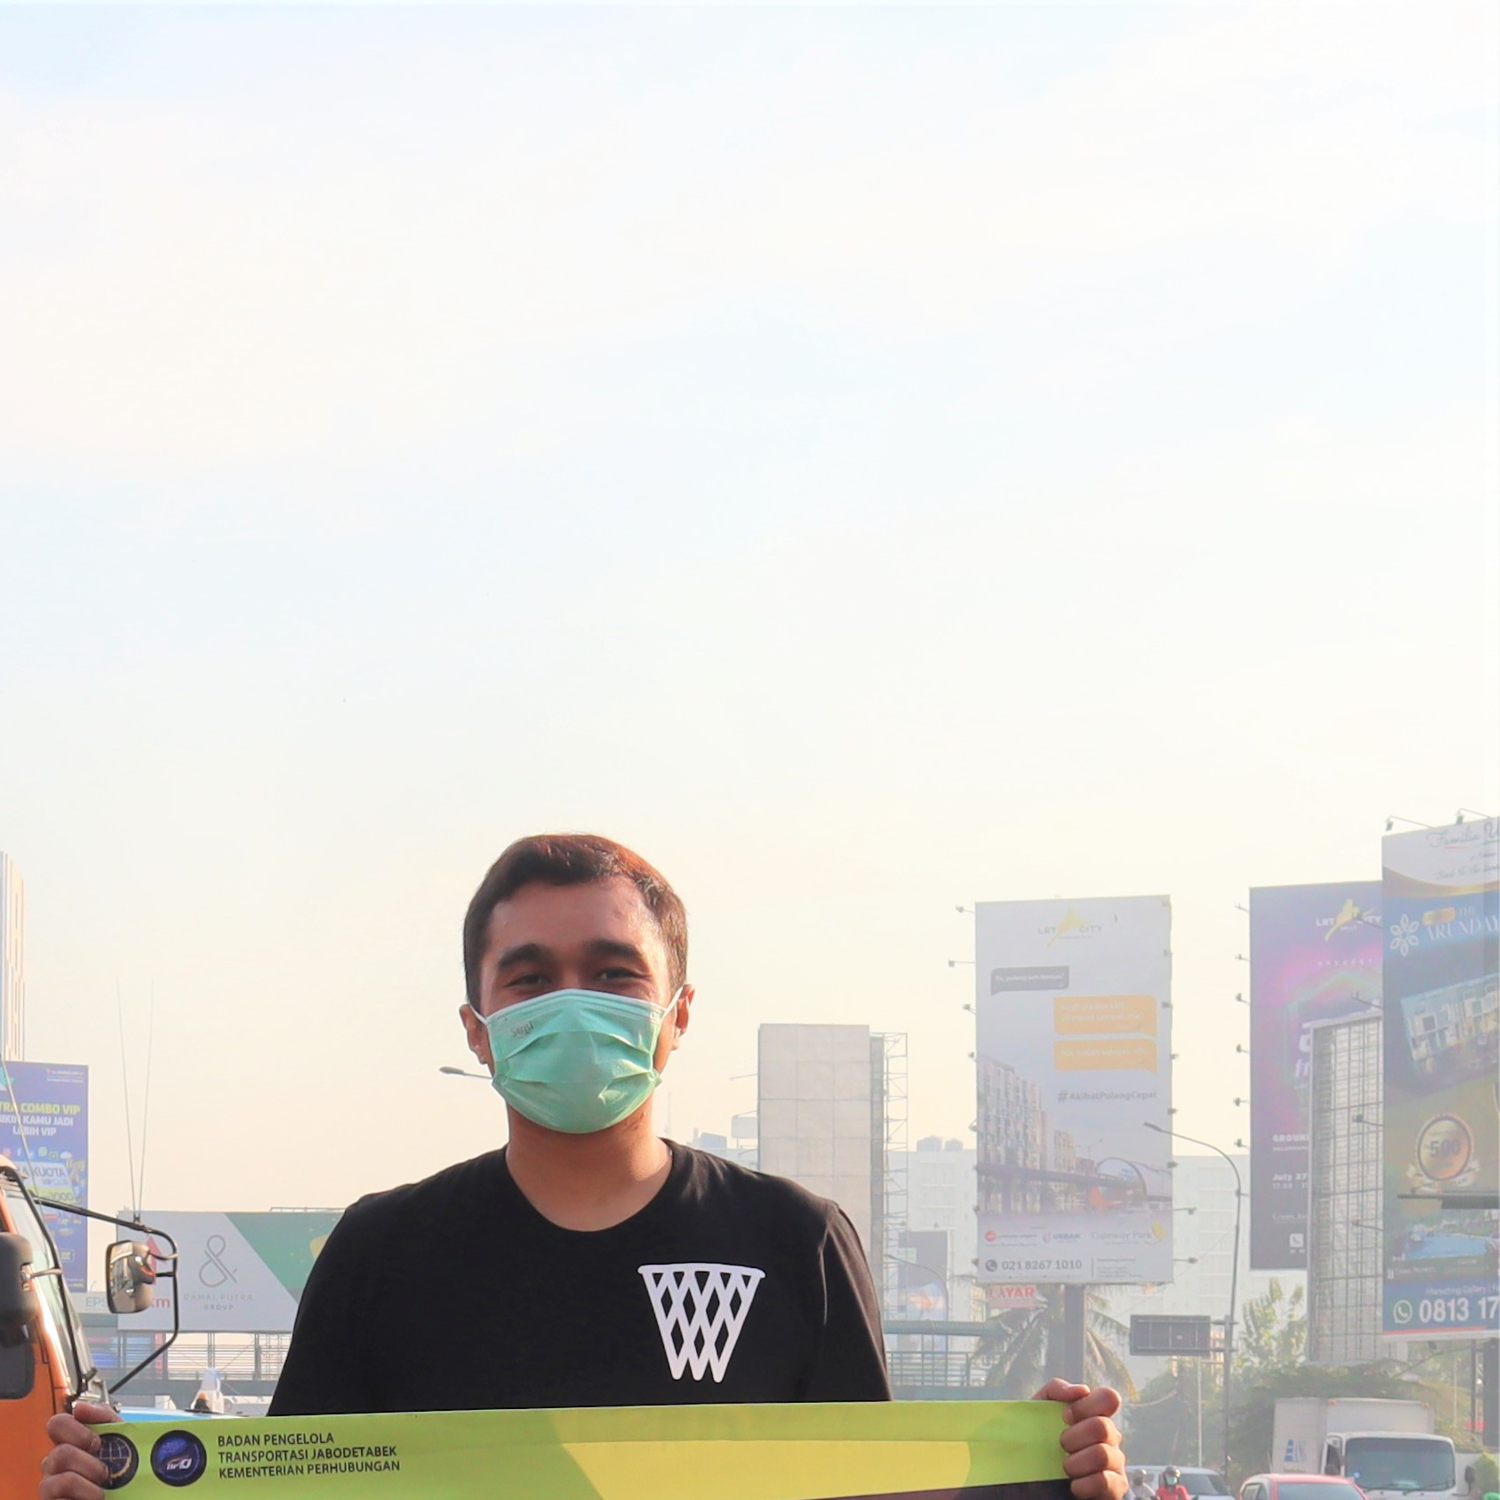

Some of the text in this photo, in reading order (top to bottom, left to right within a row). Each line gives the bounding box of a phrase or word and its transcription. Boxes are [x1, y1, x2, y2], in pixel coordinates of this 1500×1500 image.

[21, 1102, 60, 1115] COMBO
[62, 1104, 80, 1116] VIP
[23, 1115, 51, 1127] KAMU
[54, 1116, 74, 1128] JADI
[41, 1127, 57, 1137] VIP
[1002, 1259, 1083, 1270] 021 8267 1010
[1419, 1297, 1470, 1323] 0813
[218, 1432, 334, 1447] BADAN PENGELOLA
[218, 1445, 397, 1463] TRANSPORTASI JABODETABEK
[219, 1460, 400, 1479] KEMENTERIAN PERHUBUNGAN
